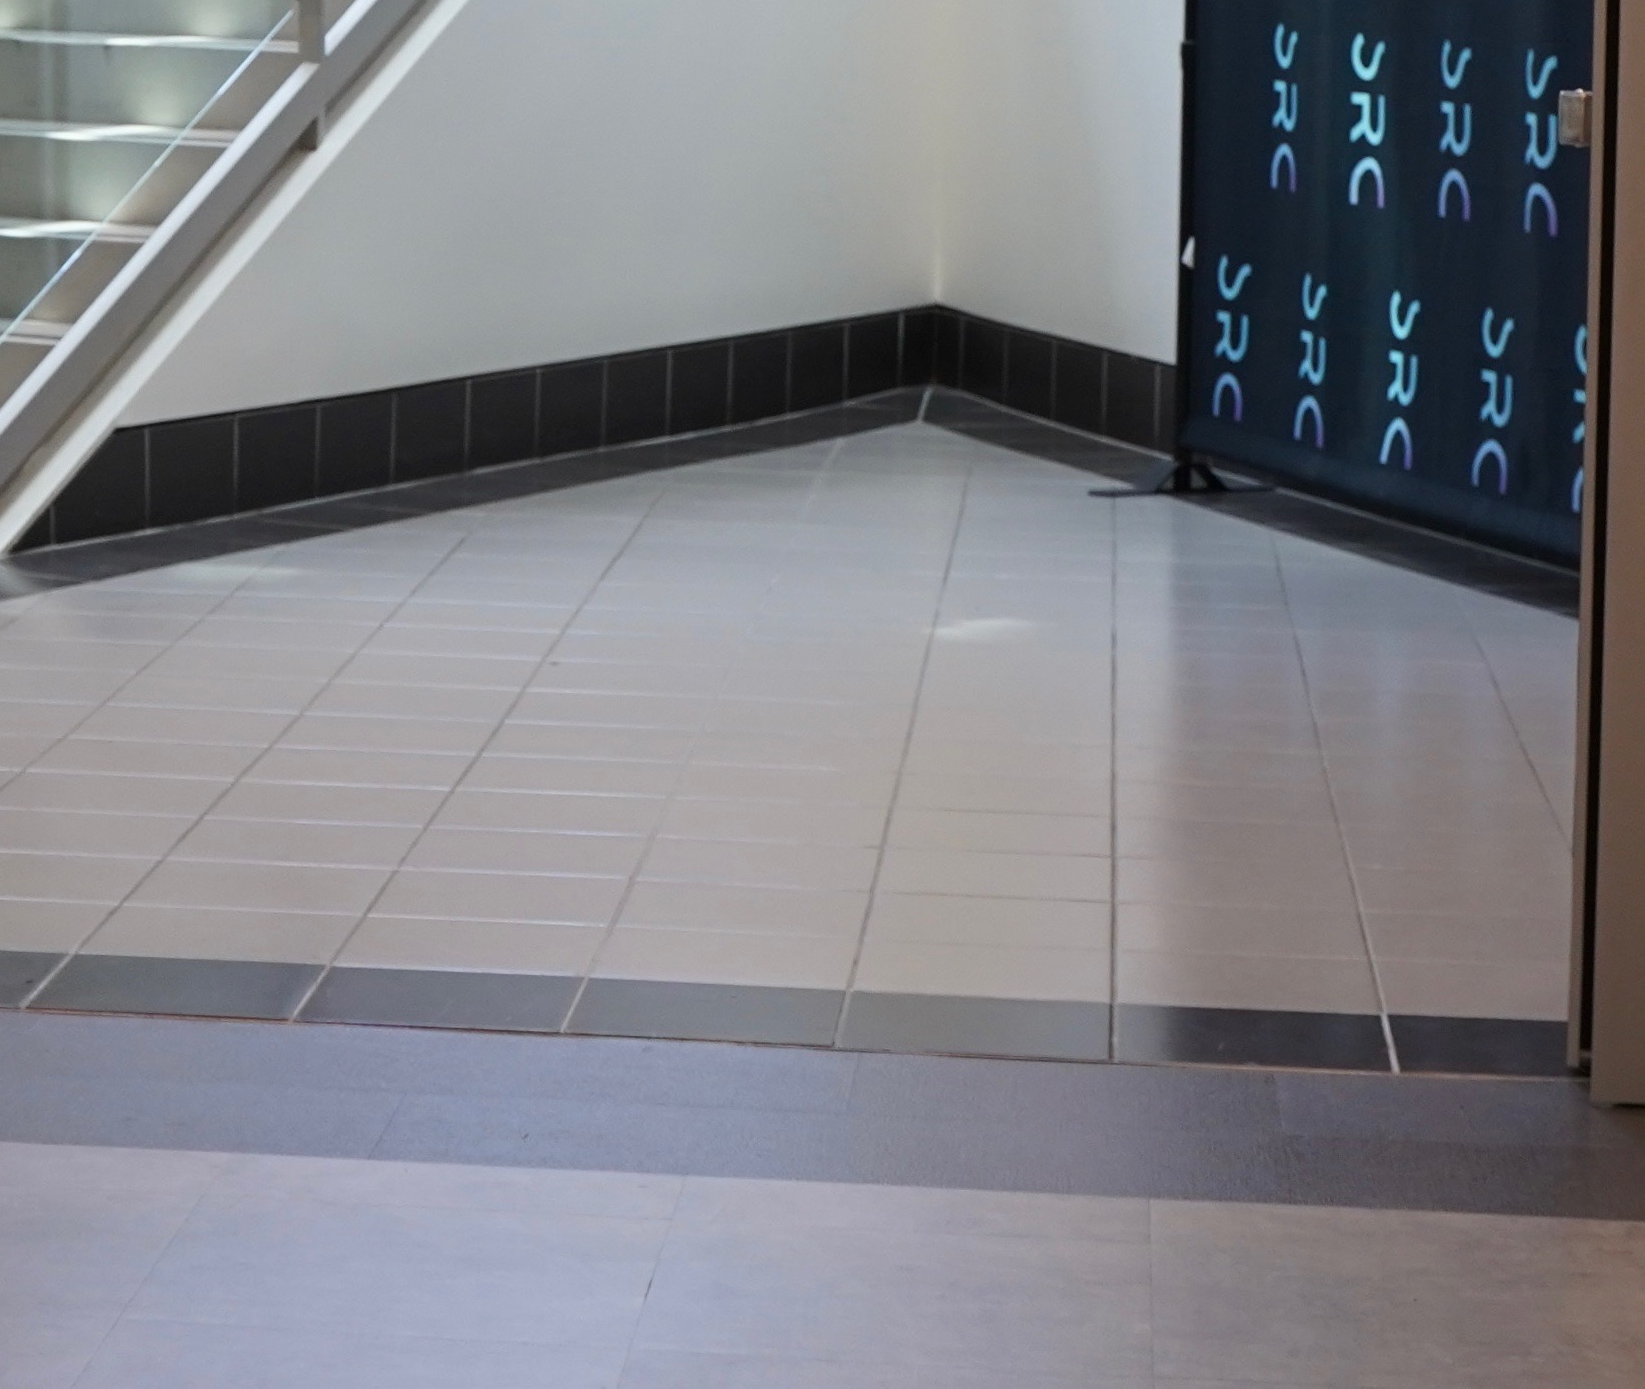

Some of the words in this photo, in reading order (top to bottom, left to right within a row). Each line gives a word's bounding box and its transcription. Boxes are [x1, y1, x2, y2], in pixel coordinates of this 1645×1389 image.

[1271, 24, 1300, 190] SRC
[1349, 33, 1387, 209] SRC
[1438, 41, 1474, 221] SRC
[1524, 50, 1559, 236] SRC
[1213, 255, 1254, 419] SRC
[1294, 274, 1329, 447] SRC
[1379, 291, 1422, 468] SRC
[1472, 308, 1516, 492] SRC
